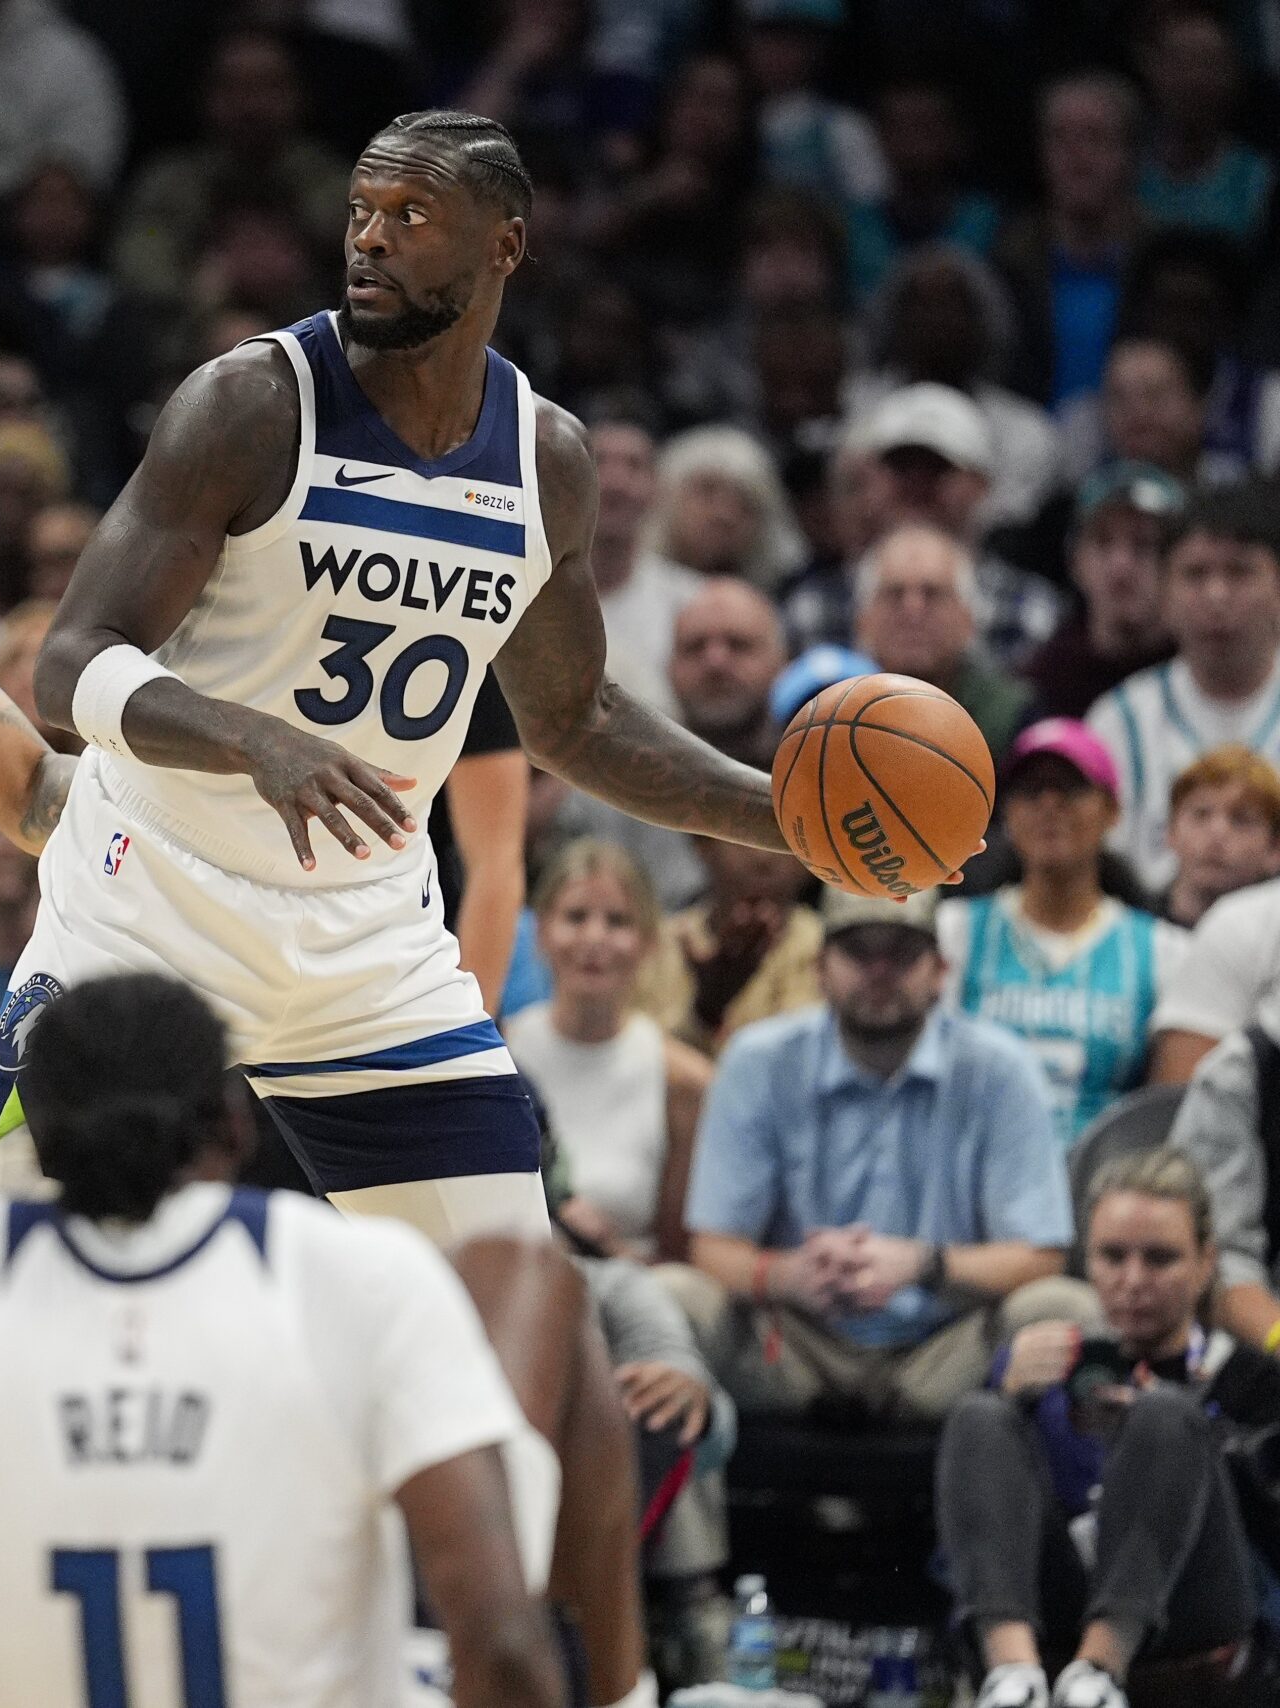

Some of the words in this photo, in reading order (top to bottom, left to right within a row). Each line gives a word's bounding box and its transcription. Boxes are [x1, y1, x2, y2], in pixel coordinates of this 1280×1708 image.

[475, 493, 515, 512] sezzle
[299, 541, 516, 624] WOLVES
[294, 614, 469, 741] 30
[56, 1386, 212, 1466] REID
[50, 1546, 228, 1708] 11
